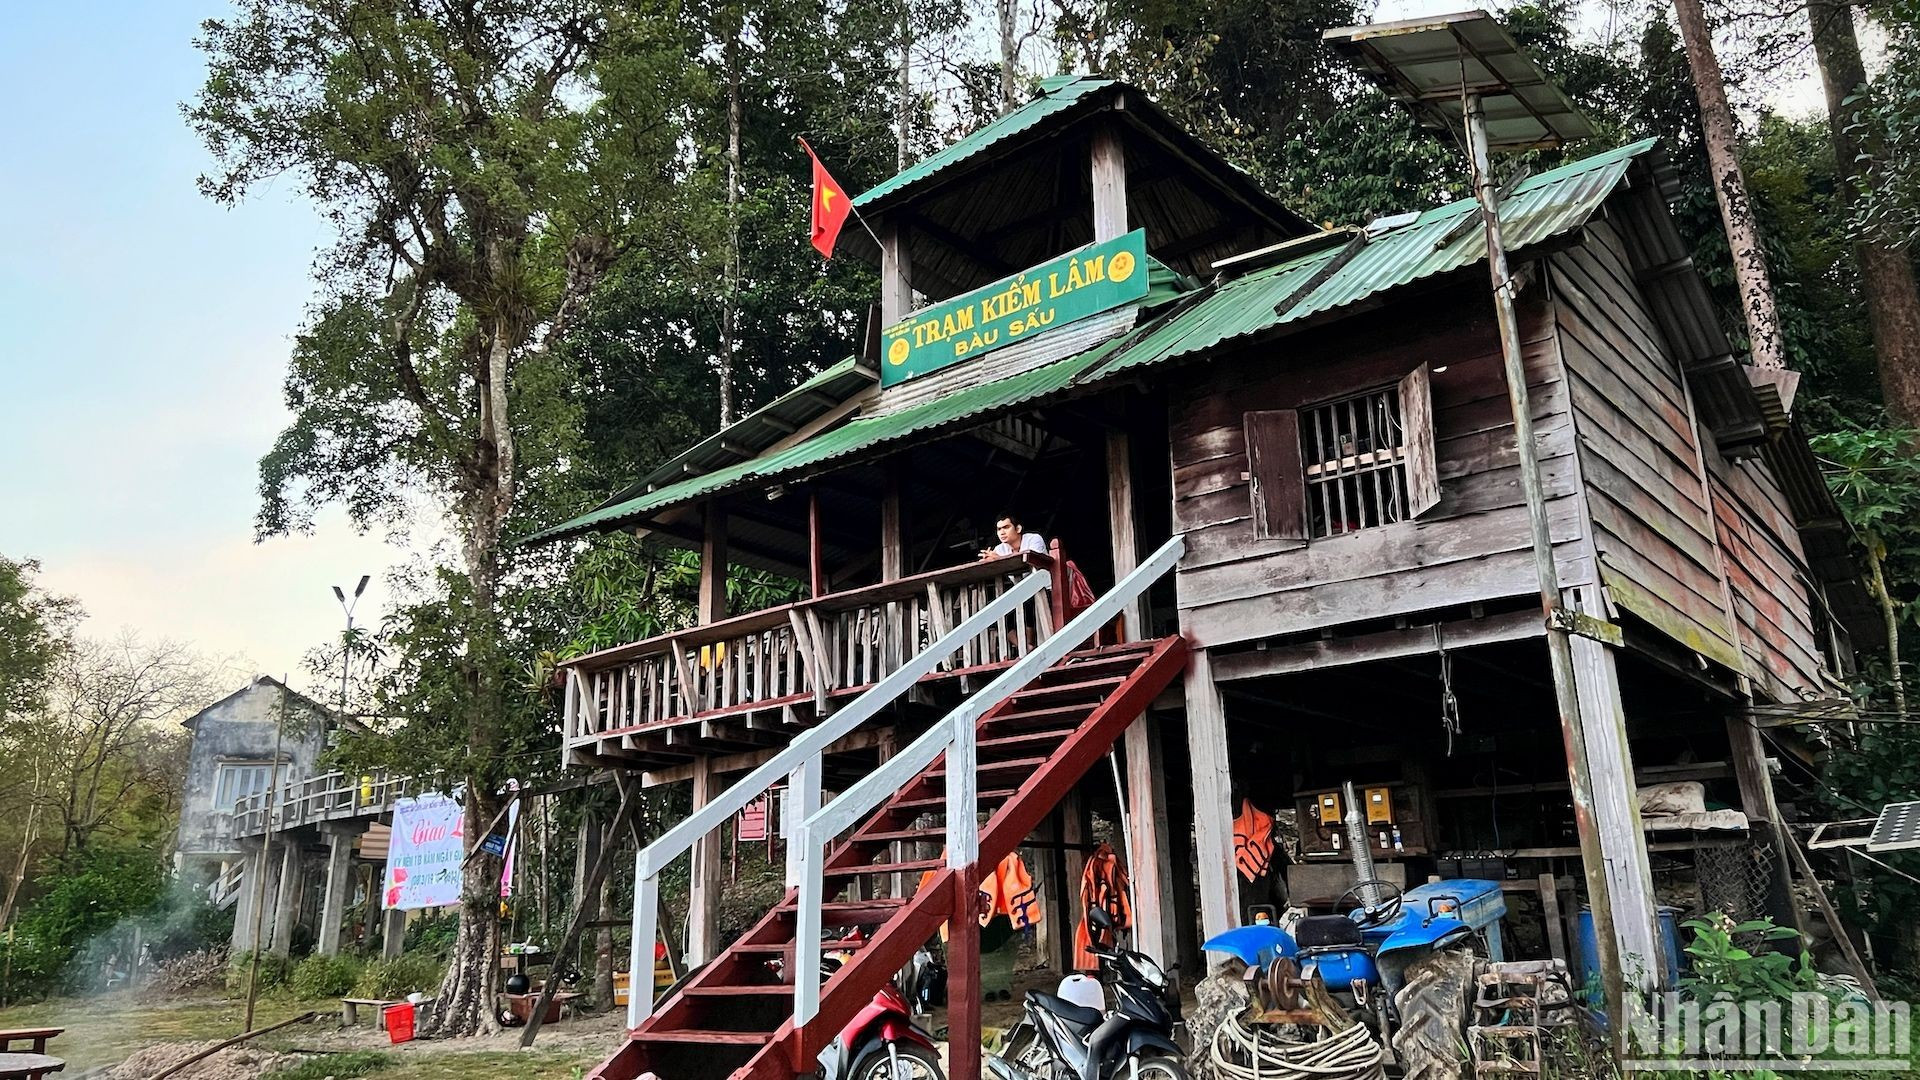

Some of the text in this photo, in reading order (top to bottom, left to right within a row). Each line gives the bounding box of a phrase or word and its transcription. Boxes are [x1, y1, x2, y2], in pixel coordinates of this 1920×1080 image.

[912, 304, 975, 348] TRẠM
[981, 275, 1042, 323] KIỂM
[1048, 255, 1105, 299] LÂM
[955, 308, 1056, 356] BÀU SẤU
[412, 813, 464, 847] Giao L
